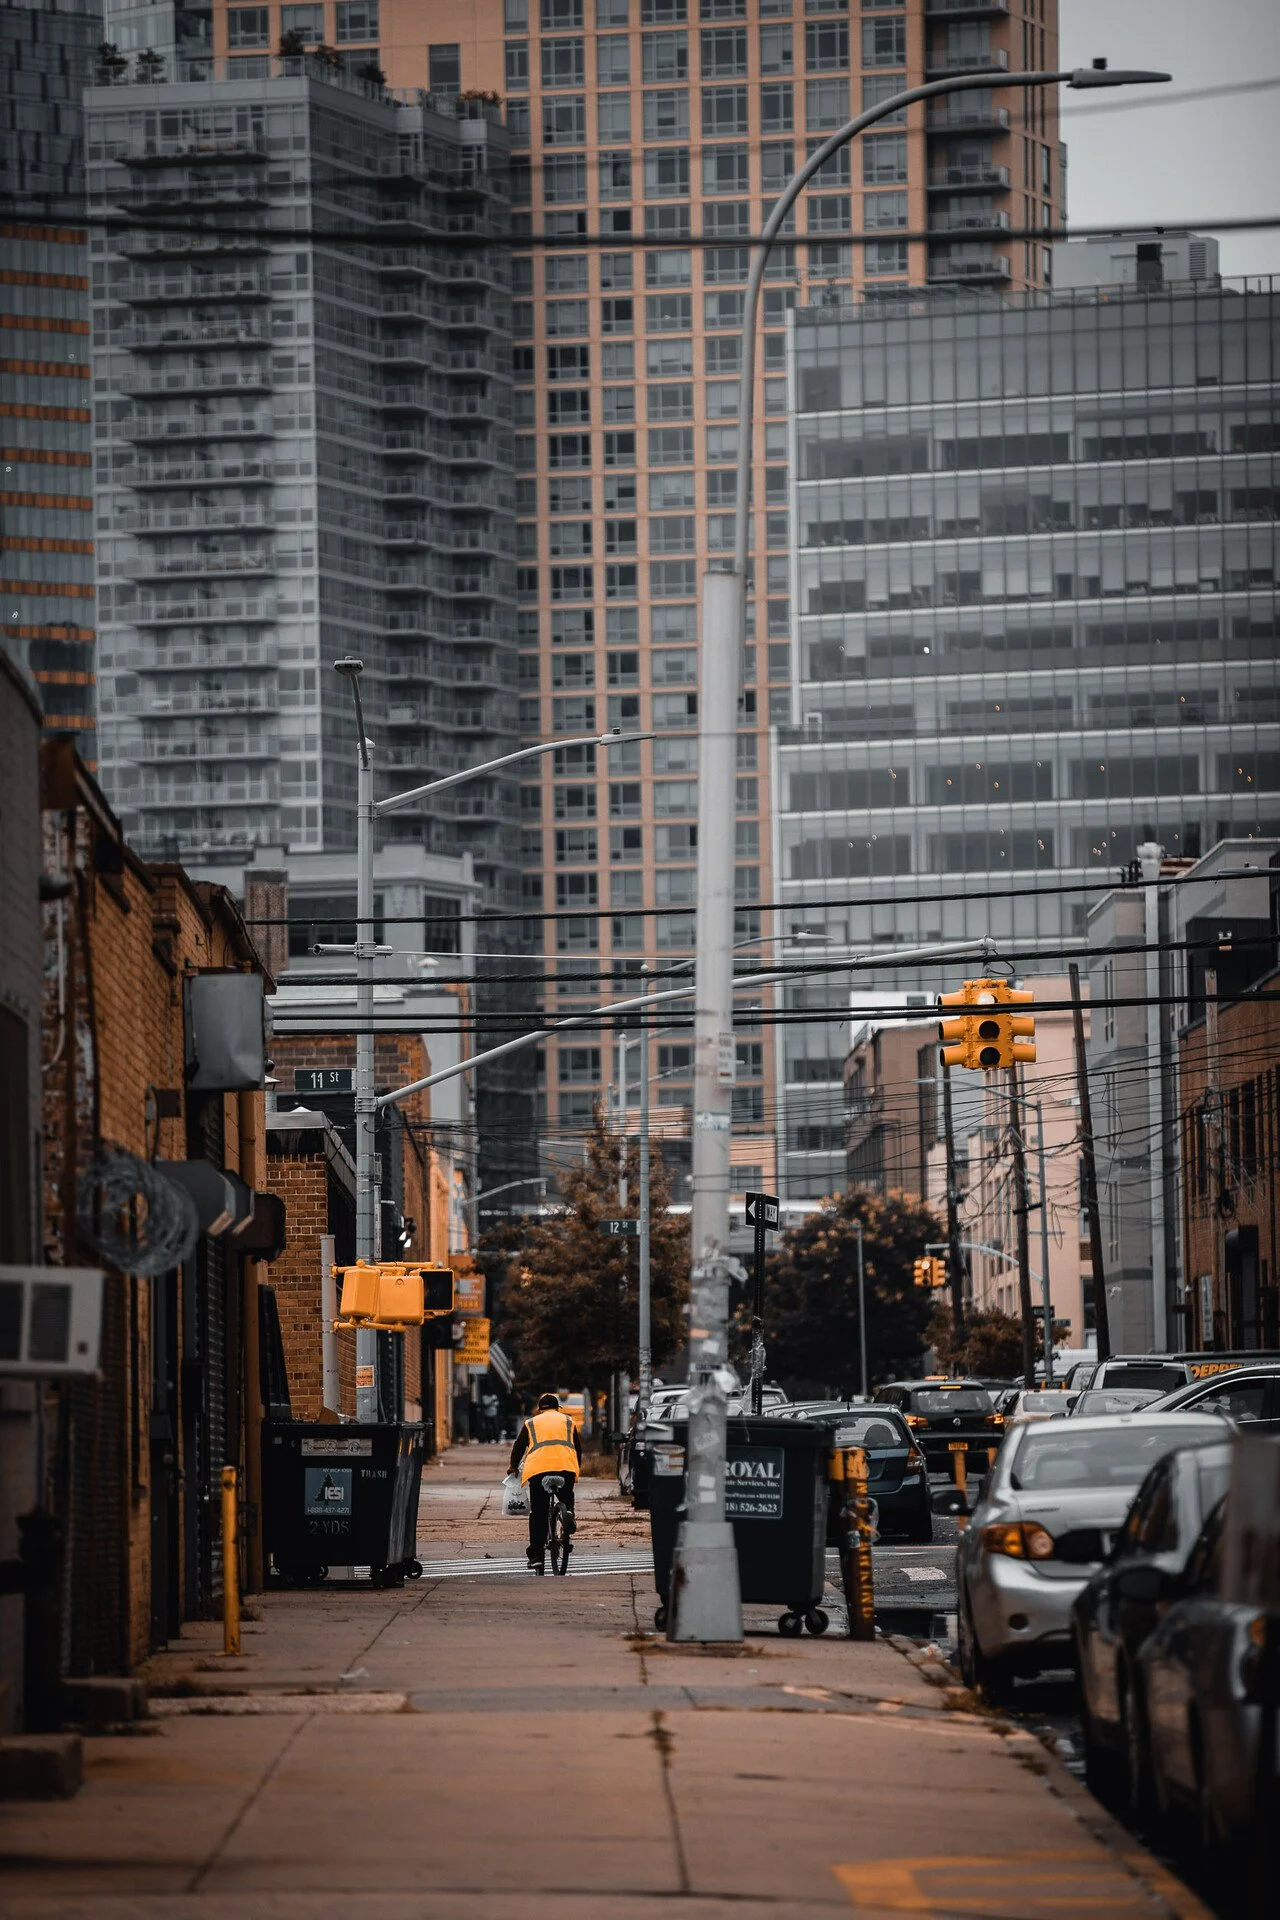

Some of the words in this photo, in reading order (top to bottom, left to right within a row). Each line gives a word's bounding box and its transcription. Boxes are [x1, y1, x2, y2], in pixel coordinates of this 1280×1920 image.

[311, 1072, 323, 1089] 11
[329, 1071, 339, 1082] St
[610, 1221, 620, 1234] 12
[361, 1469, 388, 1479] TRASH
[725, 1502, 739, 1512] 18)
[740, 1503, 778, 1513] 526-2623
[309, 1520, 319, 1535] 2
[322, 1520, 350, 1535] YDS
